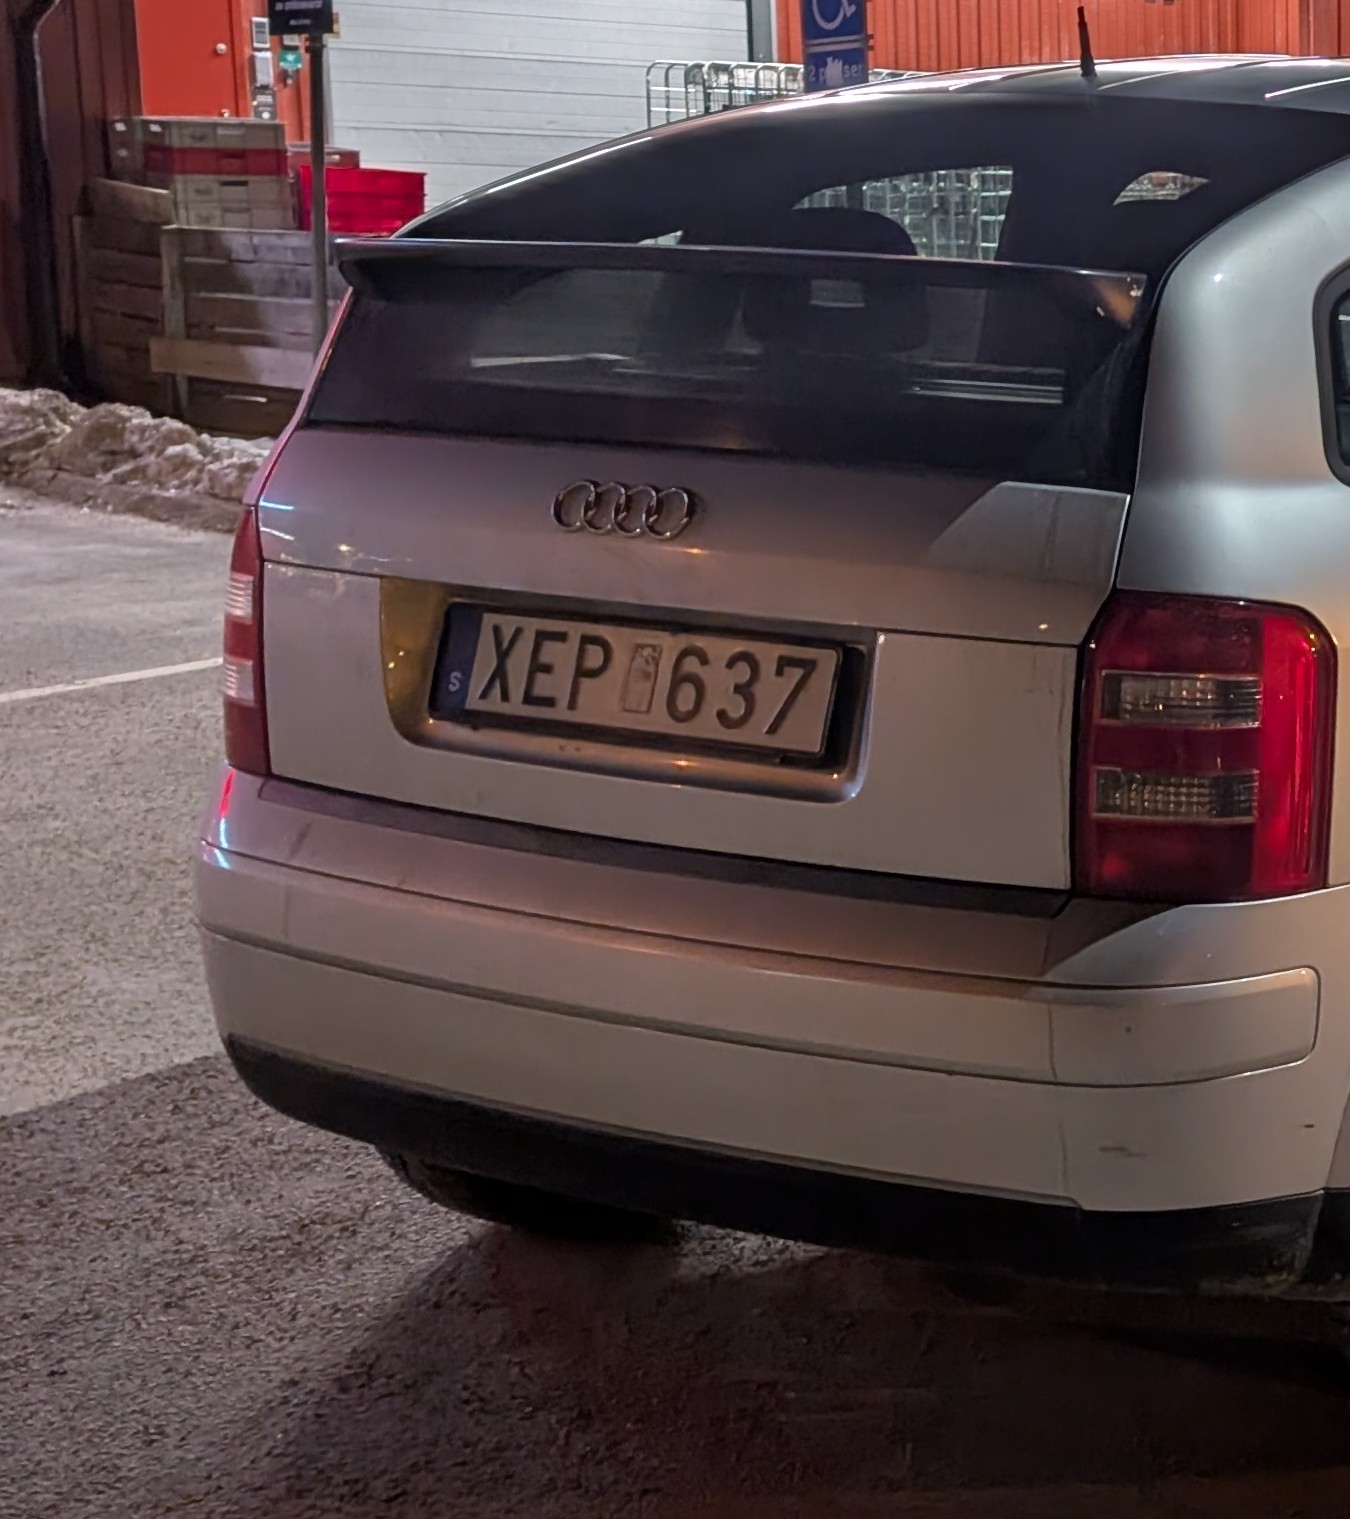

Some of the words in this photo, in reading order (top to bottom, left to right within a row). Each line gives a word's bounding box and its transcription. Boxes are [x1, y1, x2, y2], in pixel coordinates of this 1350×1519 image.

[808, 65, 817, 82] 2
[819, 63, 864, 85] pser
[447, 671, 461, 693] S
[478, 624, 614, 711] XEP
[666, 645, 817, 735] 637
